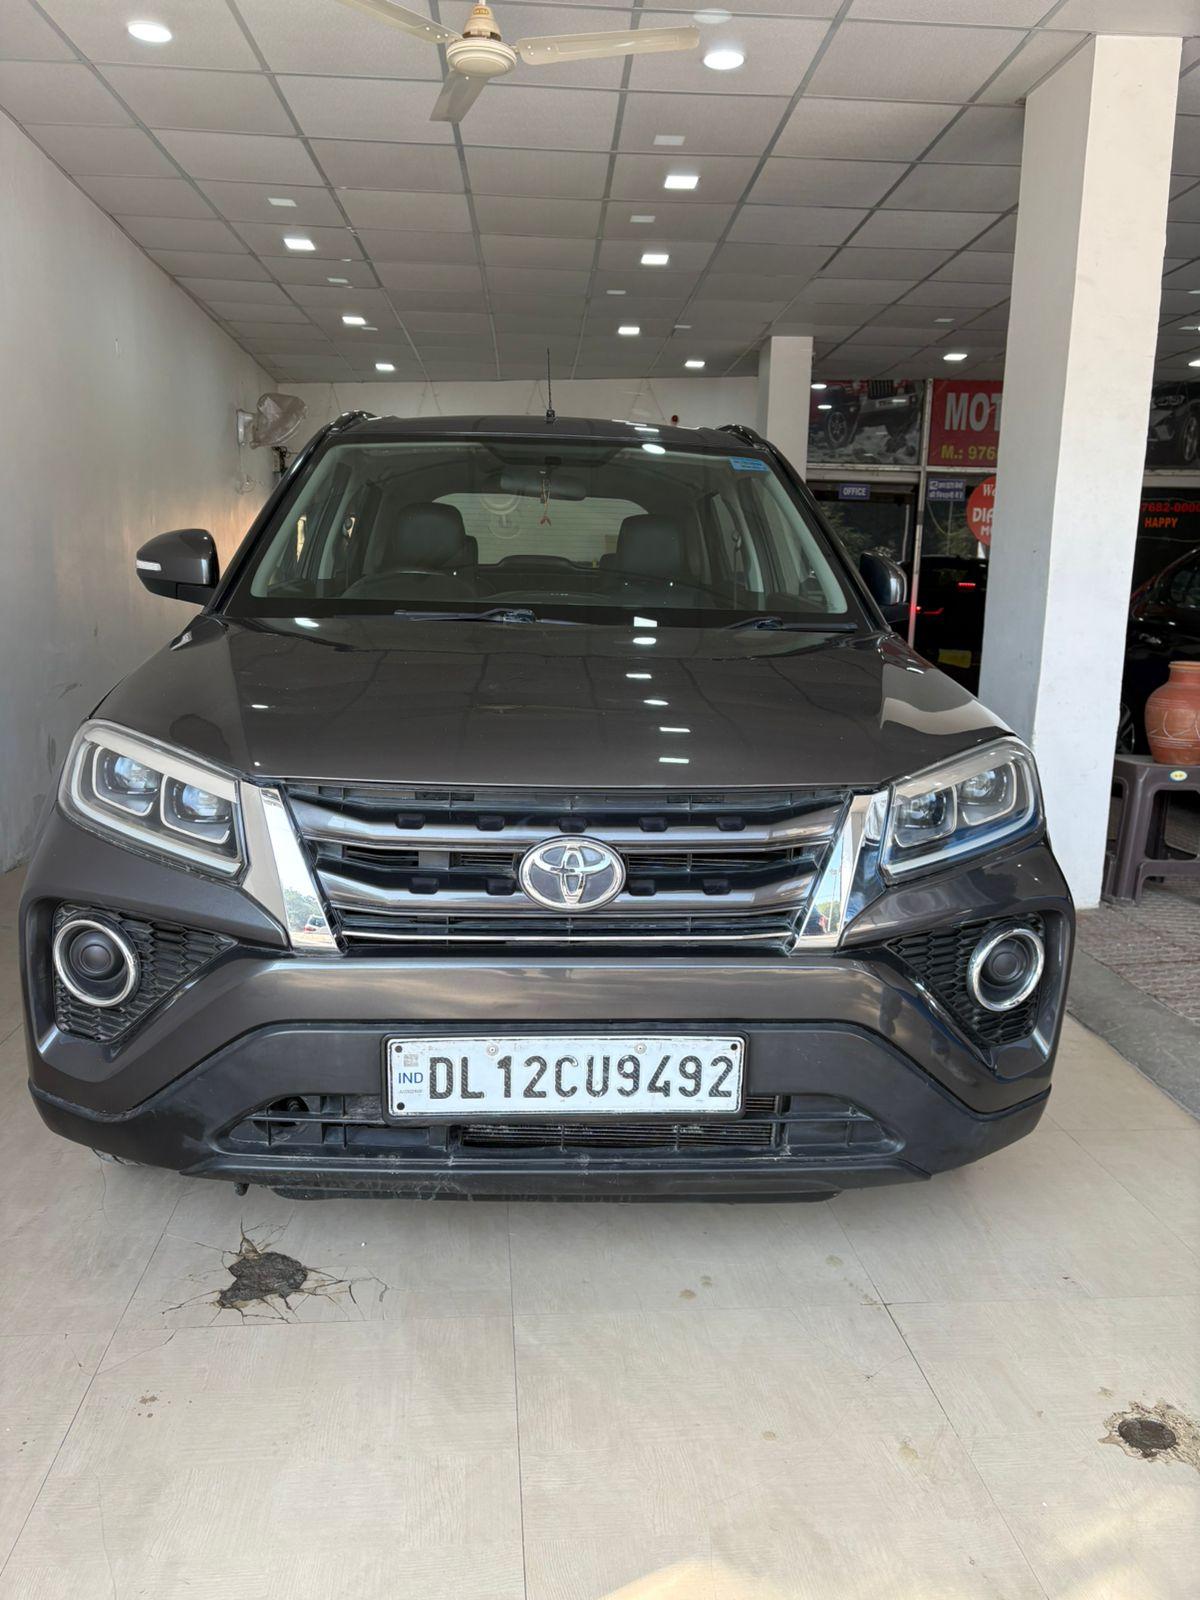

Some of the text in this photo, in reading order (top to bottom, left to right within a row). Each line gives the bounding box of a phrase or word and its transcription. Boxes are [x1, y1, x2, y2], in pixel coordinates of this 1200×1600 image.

[944, 392, 1002, 432] MOT
[968, 446, 997, 460] 976
[842, 487, 867, 496] OFFICE
[1144, 517, 1178, 528] HAPPY
[980, 525, 992, 536] M
[398, 1071, 424, 1085] IND
